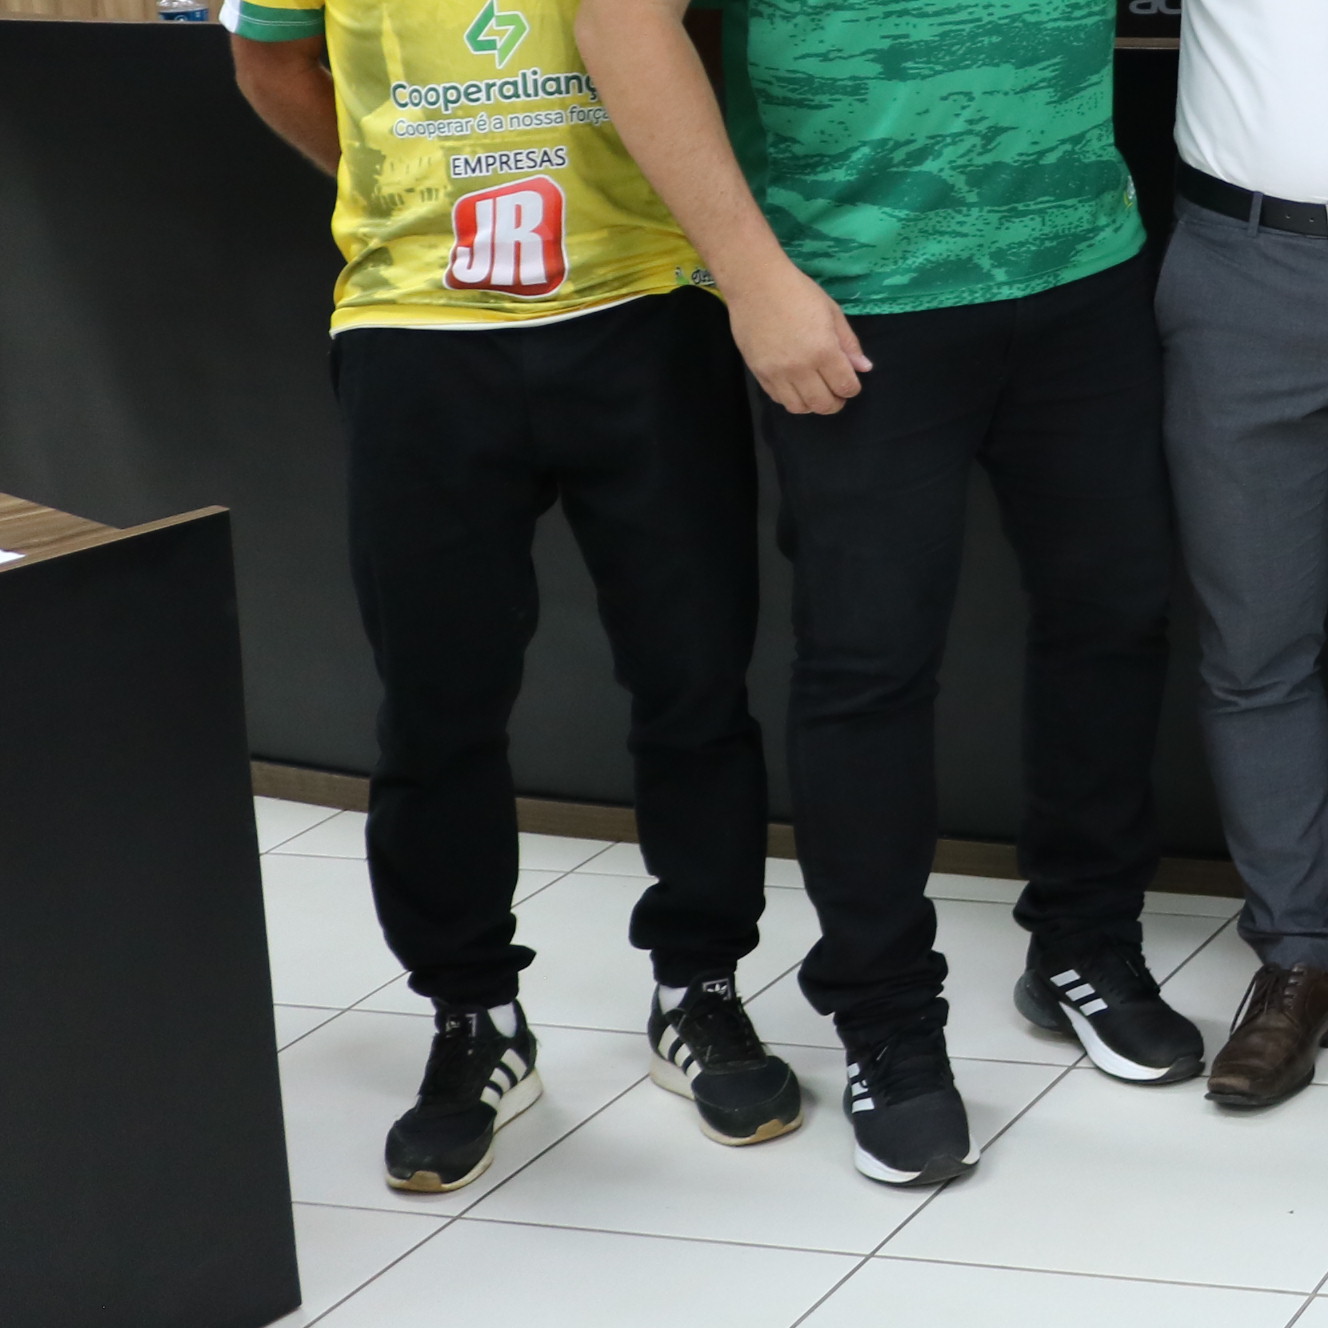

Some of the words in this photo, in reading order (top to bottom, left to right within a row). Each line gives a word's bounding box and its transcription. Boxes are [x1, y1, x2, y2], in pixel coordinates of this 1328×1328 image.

[392, 69, 600, 111] Cooperalianç
[394, 119, 473, 138] Cooperar
[492, 117, 503, 129] a
[509, 111, 564, 128] nossa
[568, 105, 610, 125] força
[452, 148, 566, 176] EMPRESAS
[452, 190, 547, 285] JR
